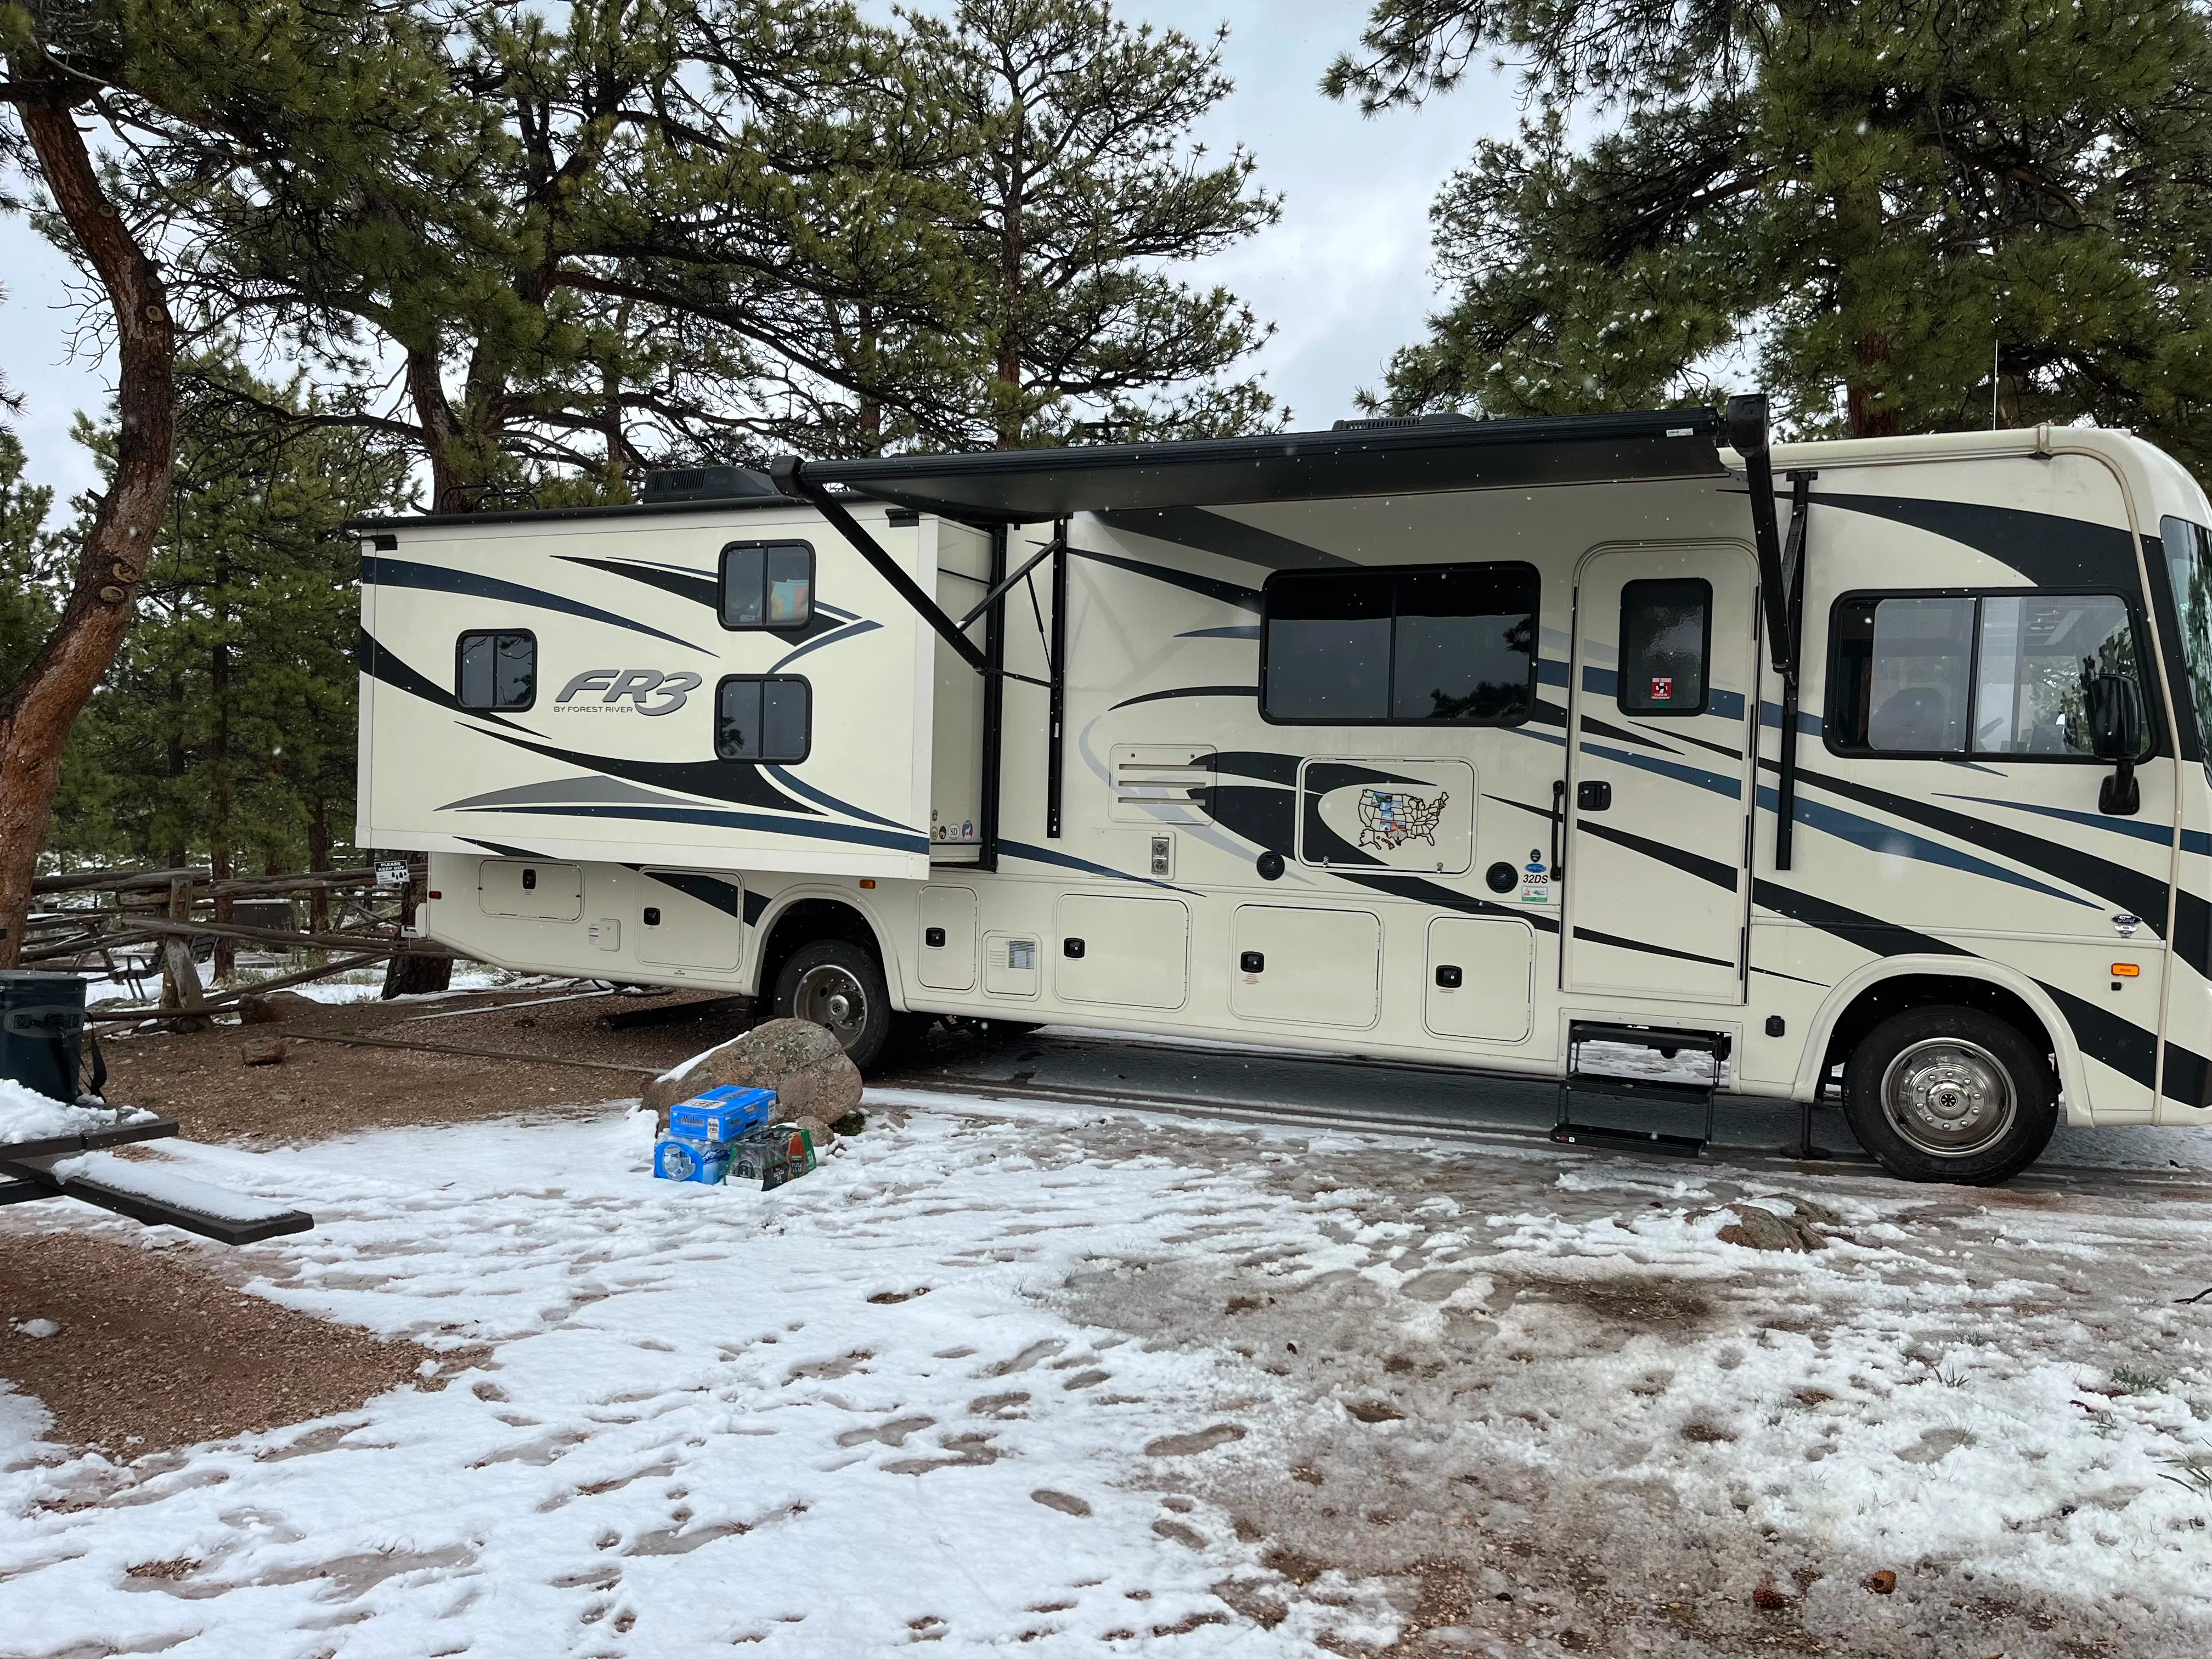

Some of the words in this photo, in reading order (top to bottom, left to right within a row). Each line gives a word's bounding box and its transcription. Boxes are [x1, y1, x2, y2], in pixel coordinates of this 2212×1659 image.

[555, 669, 703, 716] FR3
[1523, 874, 1548, 884] 32DS
[682, 1115, 702, 1125] Modelo
